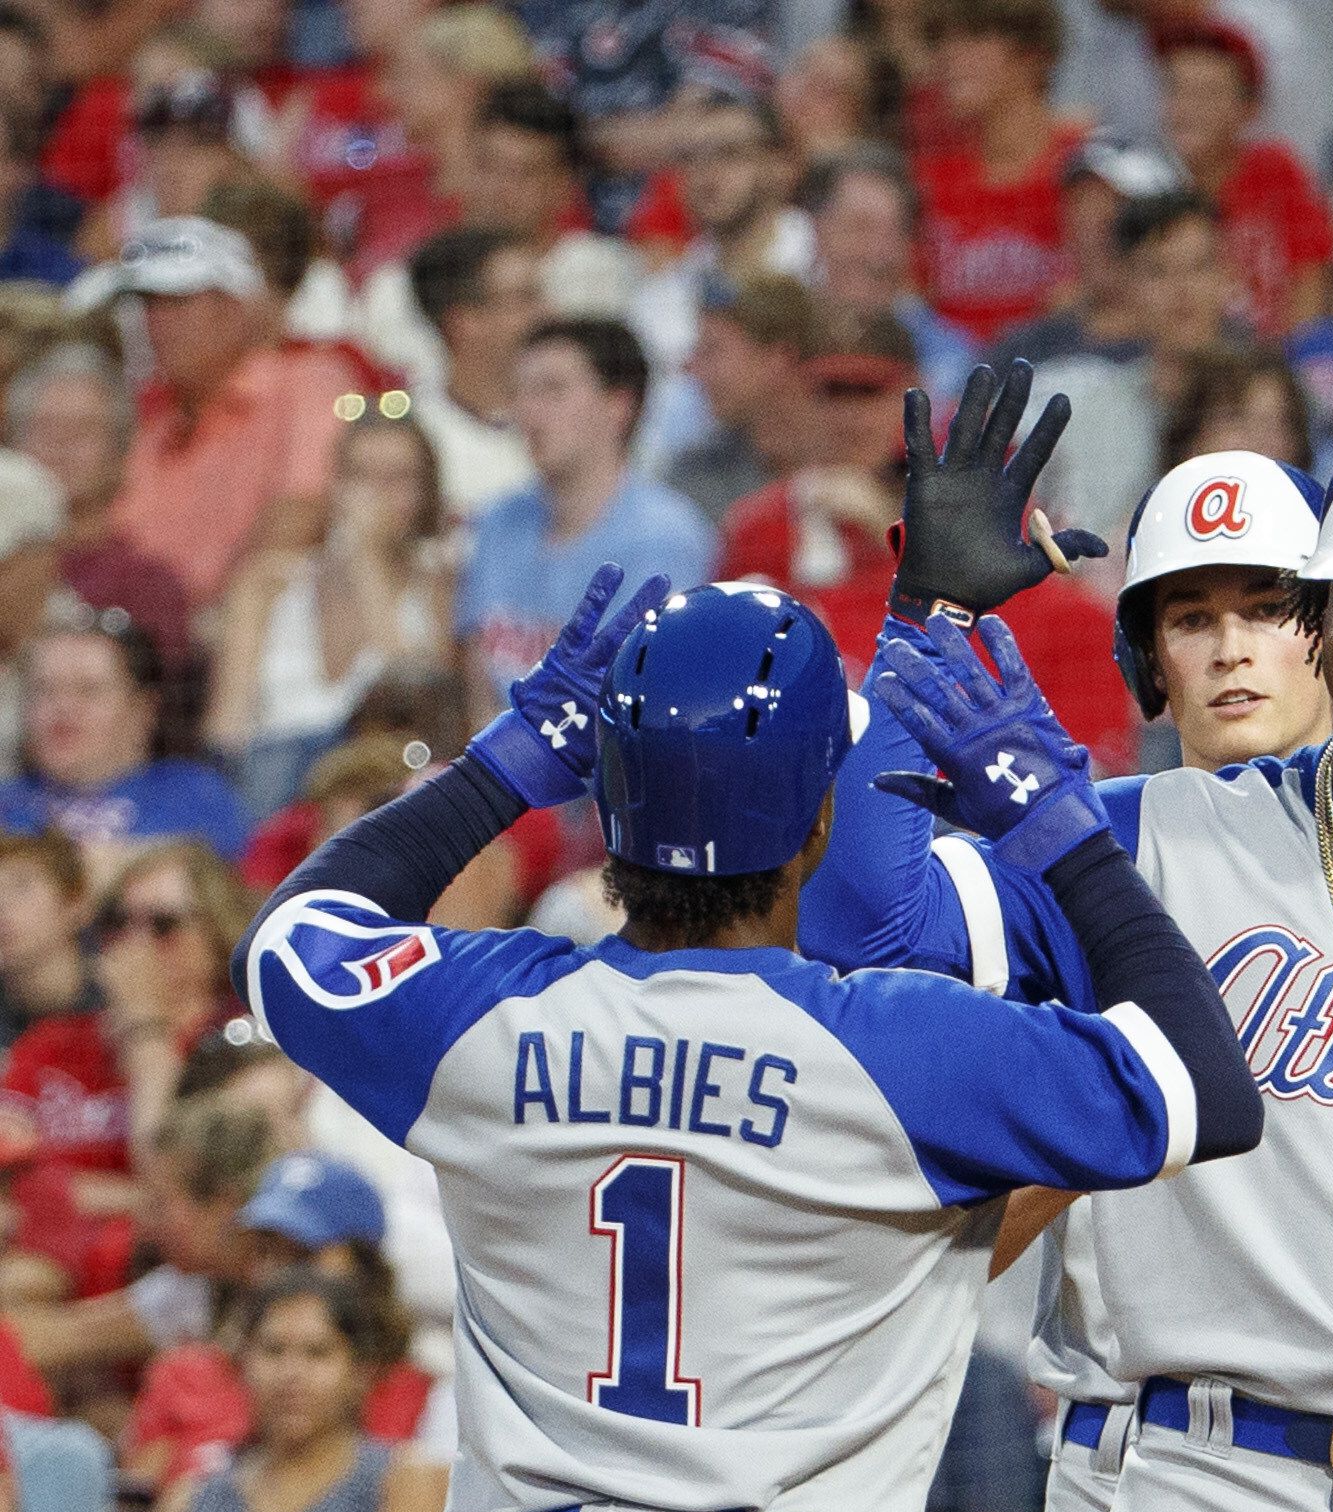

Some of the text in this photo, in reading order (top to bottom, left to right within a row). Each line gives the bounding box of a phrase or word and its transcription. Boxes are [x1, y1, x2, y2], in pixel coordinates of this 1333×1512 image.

[704, 841, 715, 872] 1
[514, 1030, 798, 1149] ALBIES
[587, 1153, 702, 1429] 1
